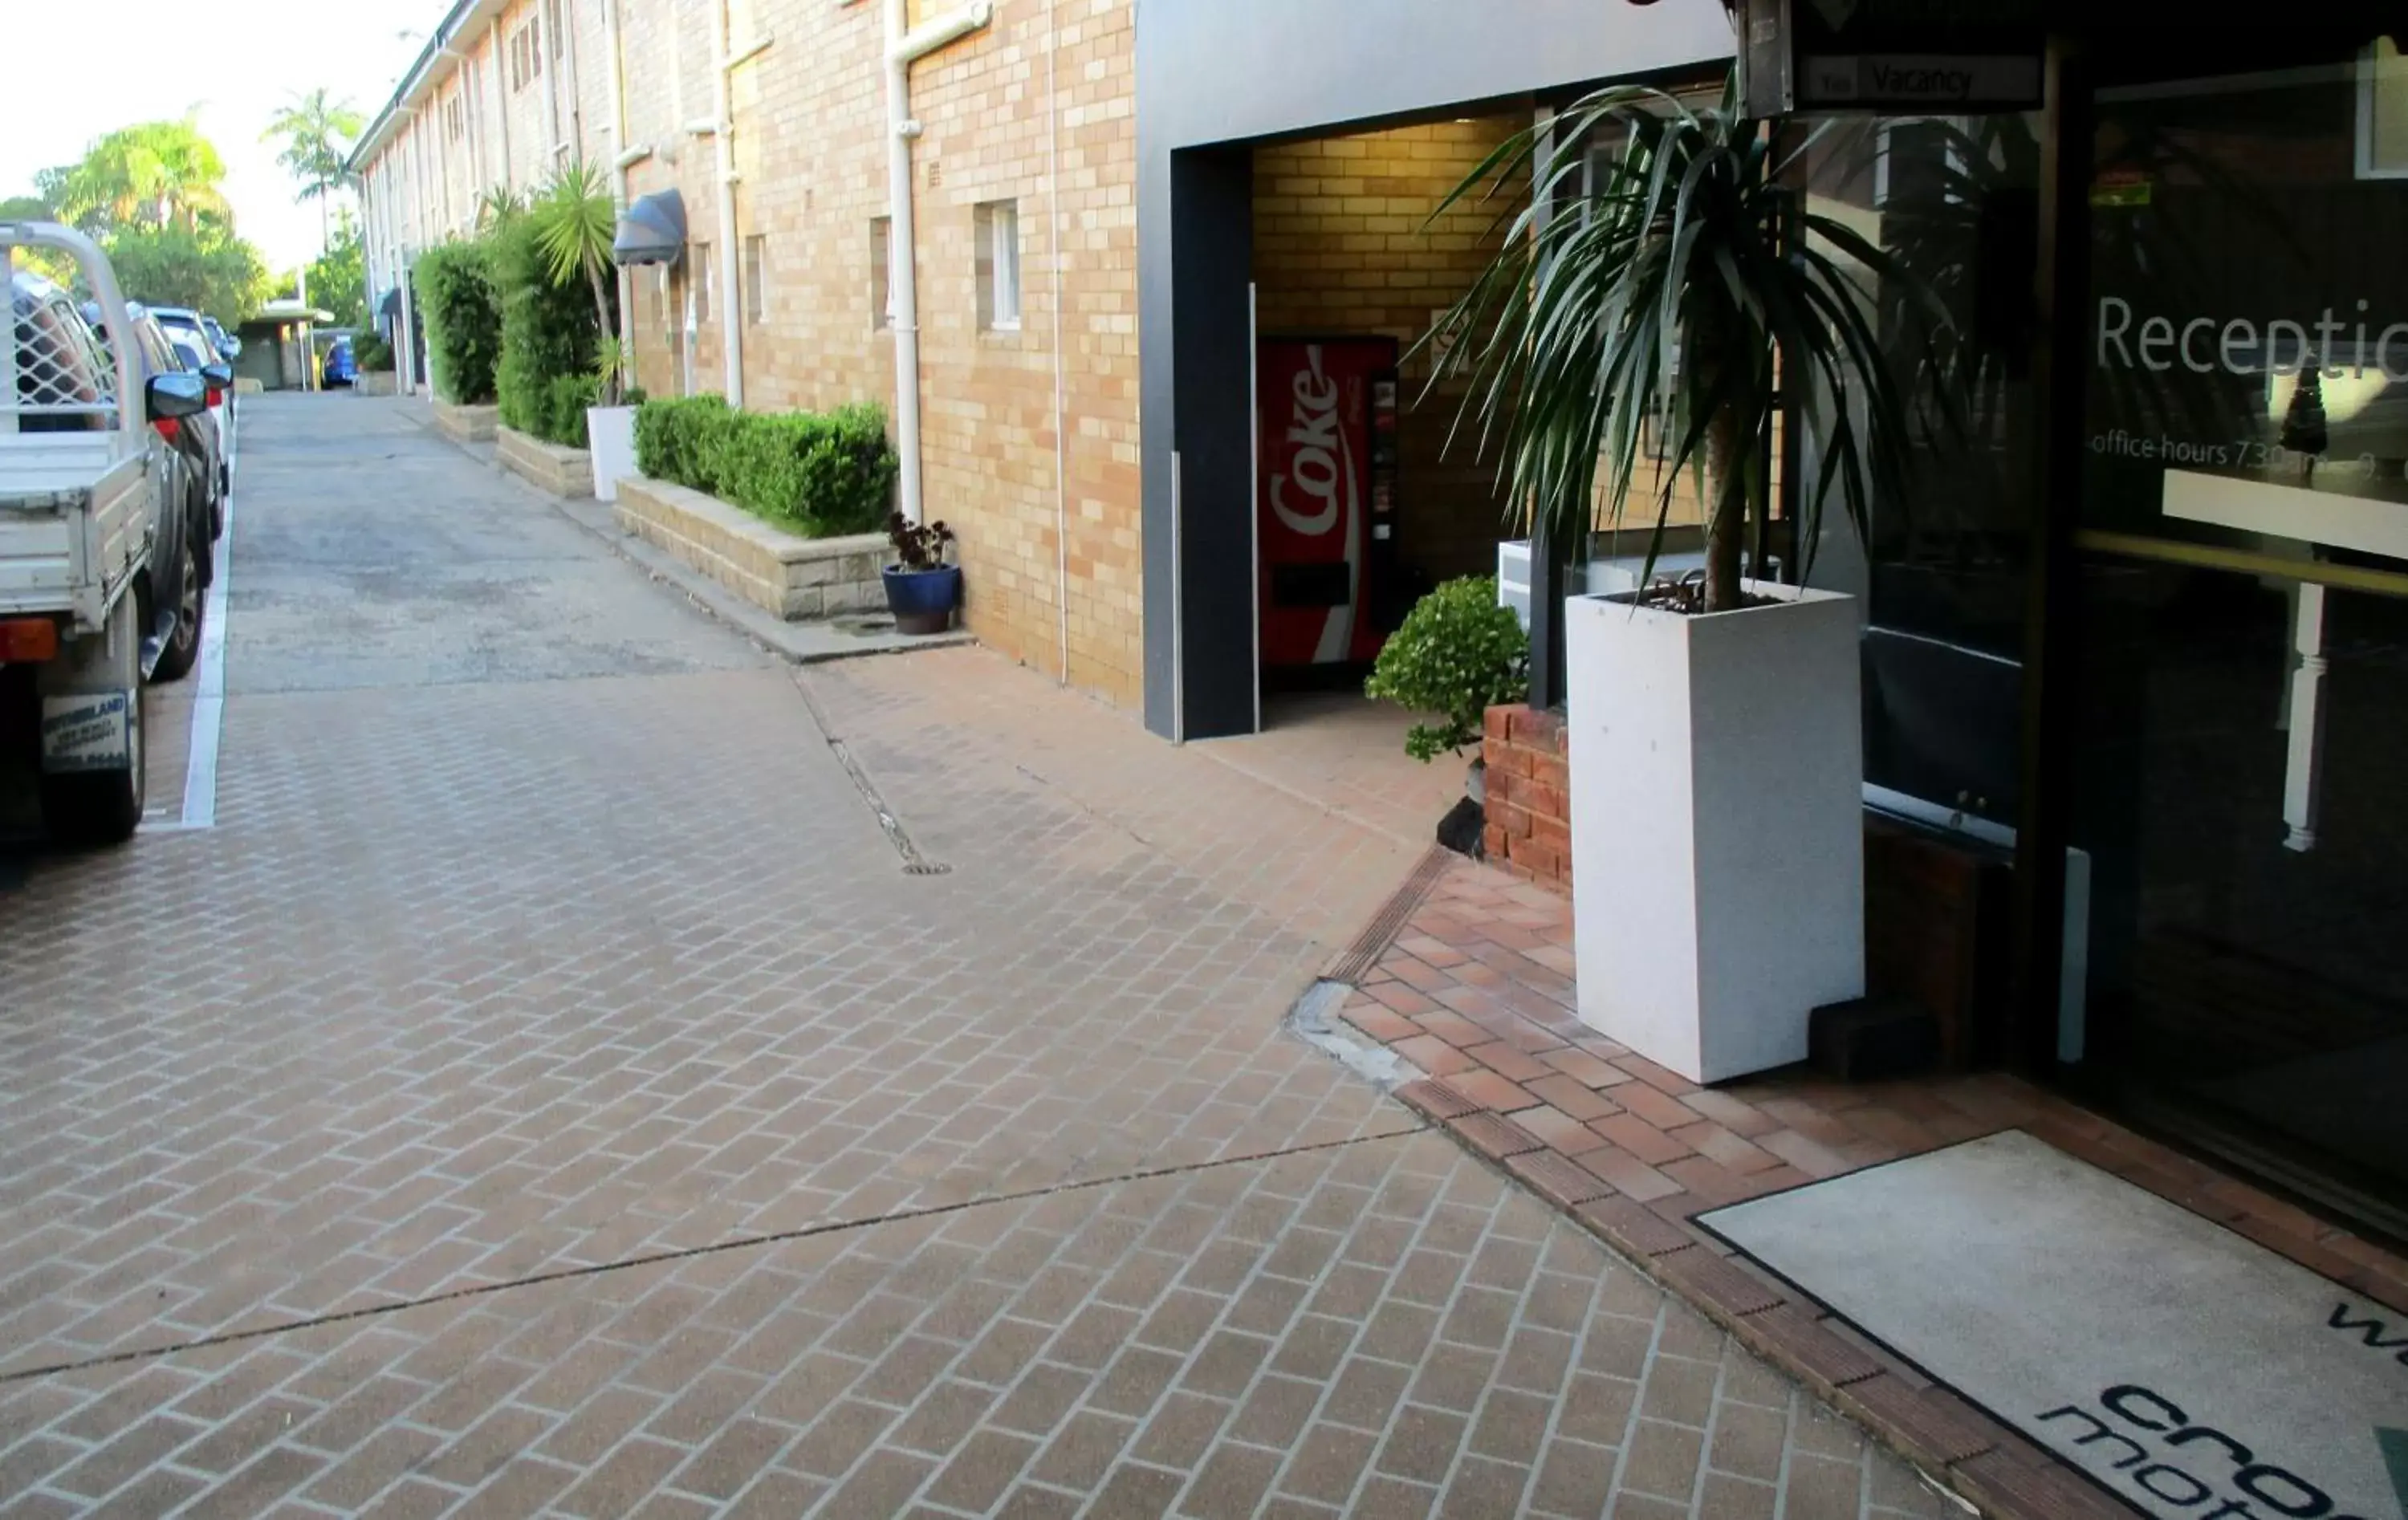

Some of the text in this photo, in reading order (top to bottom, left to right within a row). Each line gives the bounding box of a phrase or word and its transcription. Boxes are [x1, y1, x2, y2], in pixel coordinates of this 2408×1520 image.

[1873, 63, 1973, 100] Vacancy
[1270, 343, 1338, 536] Coke
[2093, 428, 2161, 458] office
[2162, 433, 2227, 465] hours
